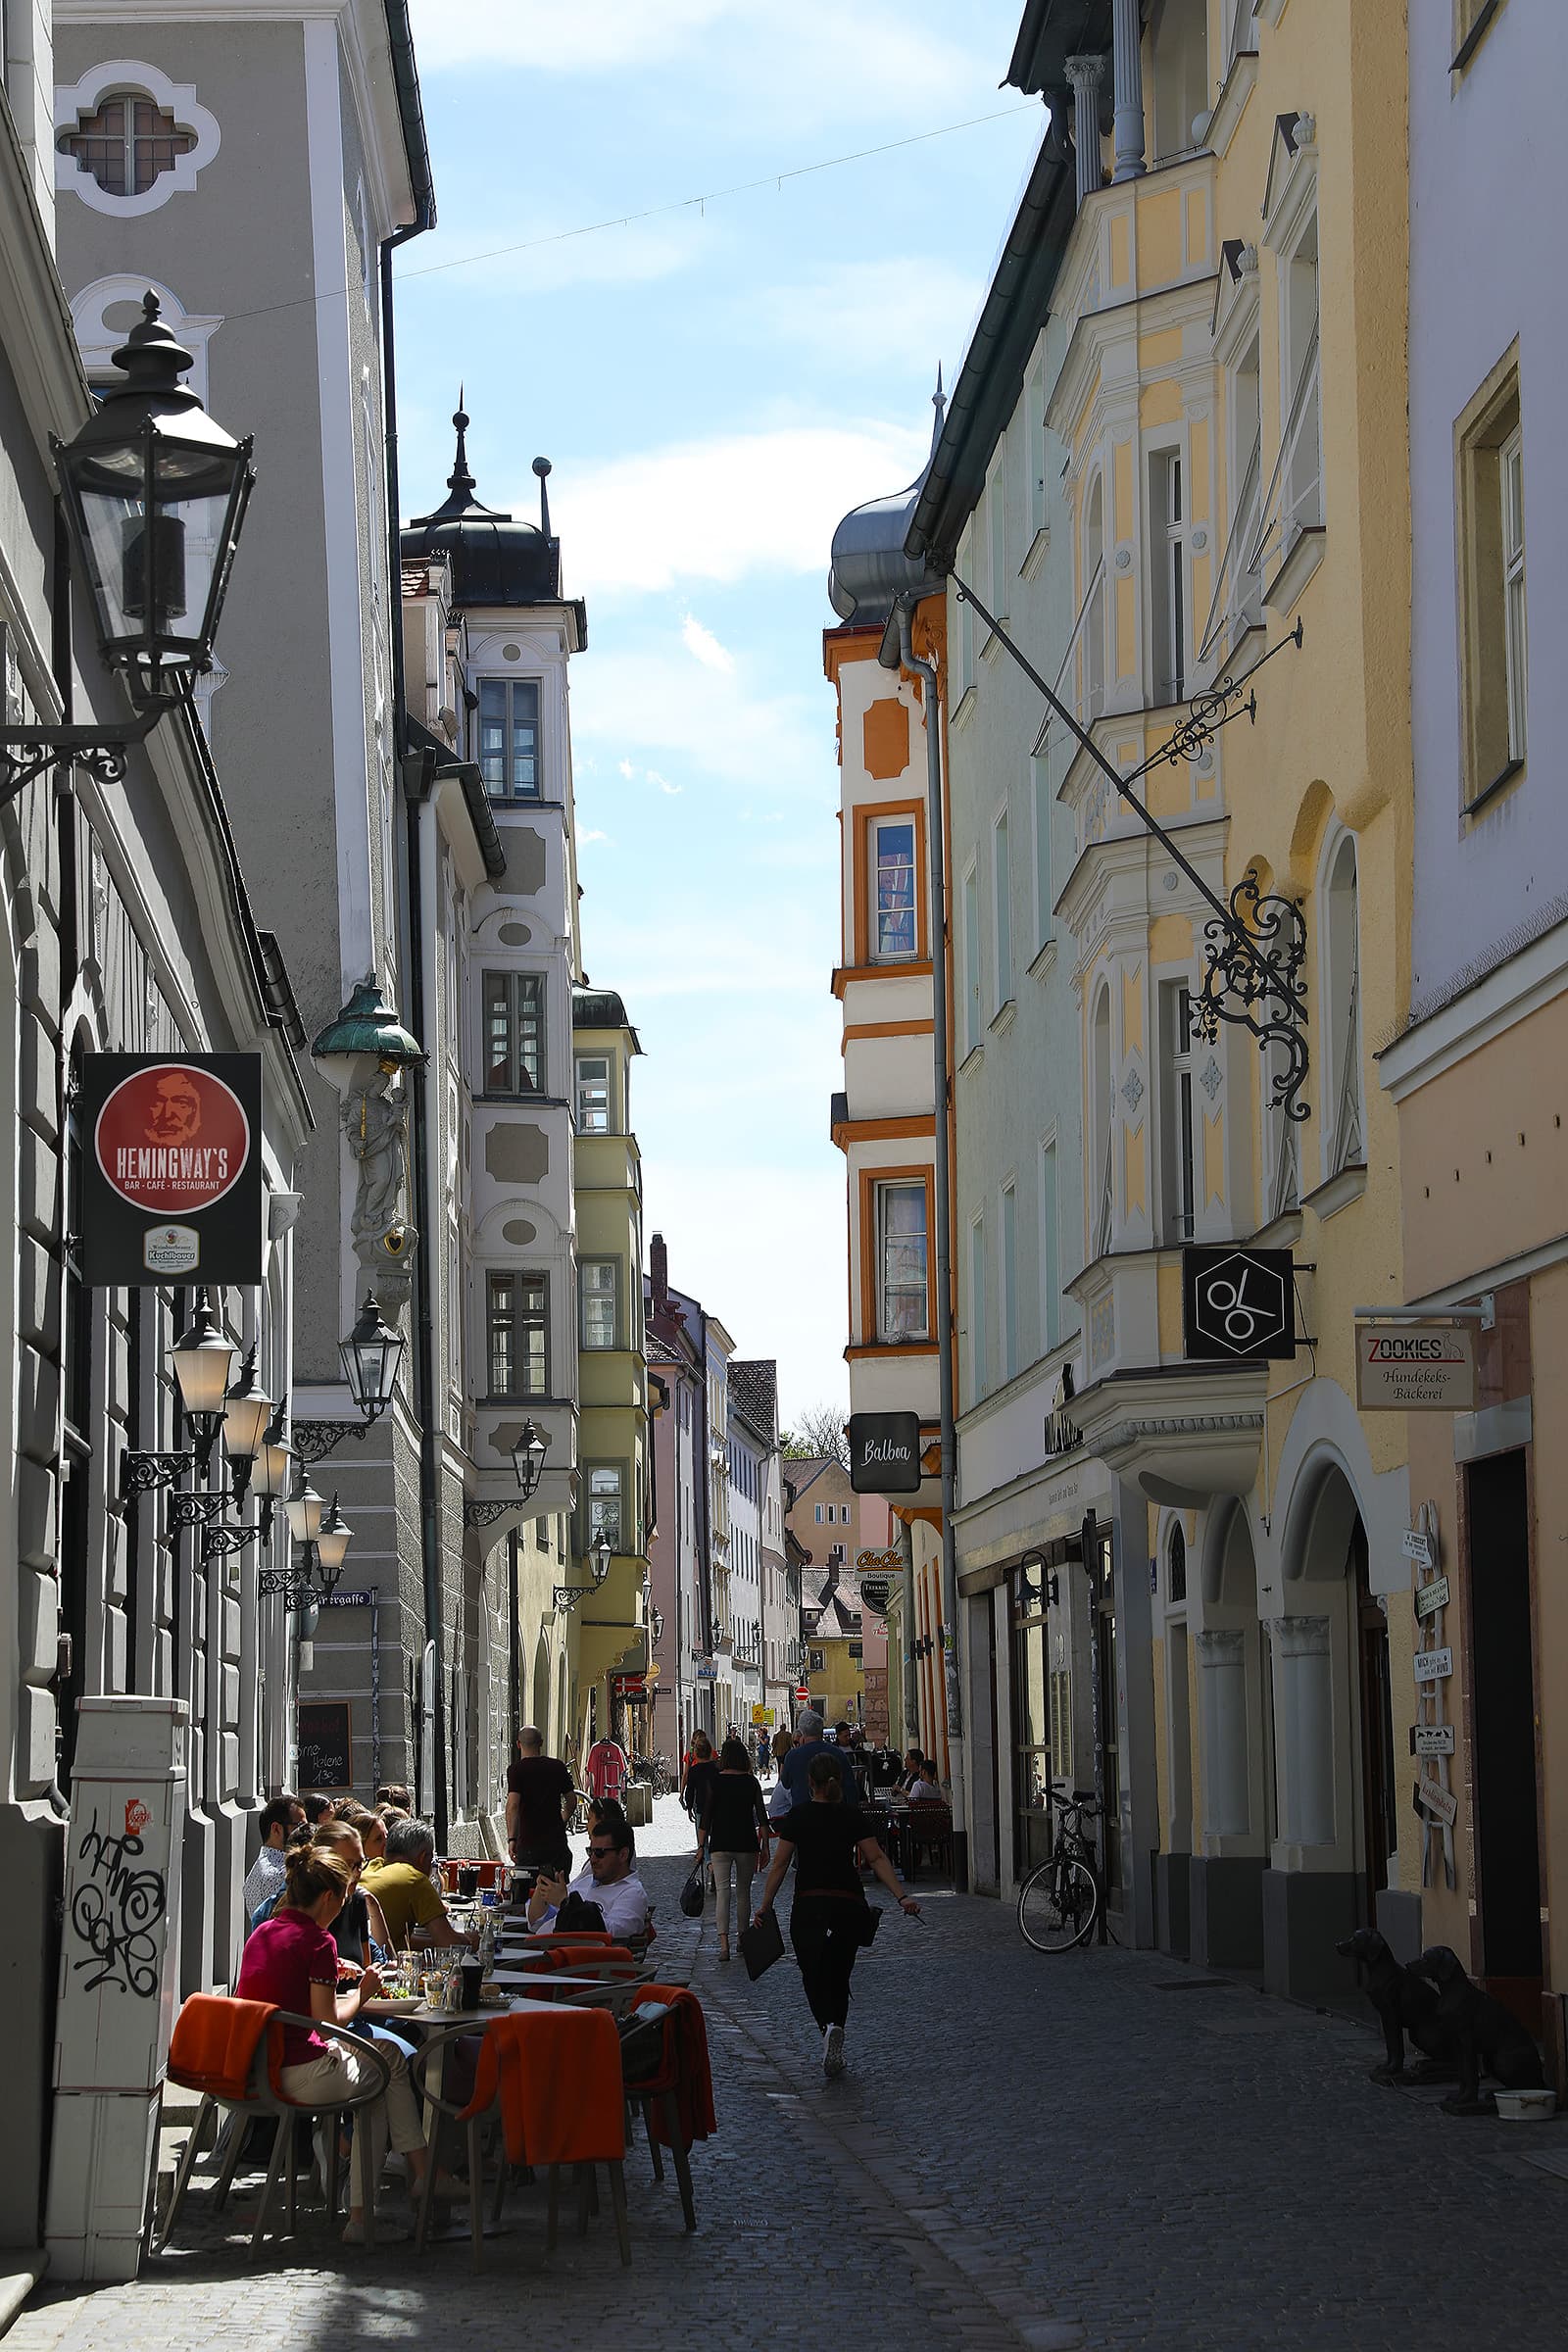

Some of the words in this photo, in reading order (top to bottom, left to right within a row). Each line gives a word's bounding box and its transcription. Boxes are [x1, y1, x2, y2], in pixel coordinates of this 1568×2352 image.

[117, 1148, 228, 1179] HEMINGWAY'S
[124, 1180, 140, 1190] BAR
[146, 1178, 166, 1190] CAFÉ
[172, 1180, 220, 1190] RESTAURANT
[149, 1250, 195, 1260] Kuchlbauer
[1368, 1339, 1442, 1361] ZOOKIES
[1383, 1368, 1450, 1384] Hundekeks-
[1394, 1385, 1443, 1399] Bäckerei
[860, 1439, 910, 1466] Balboa
